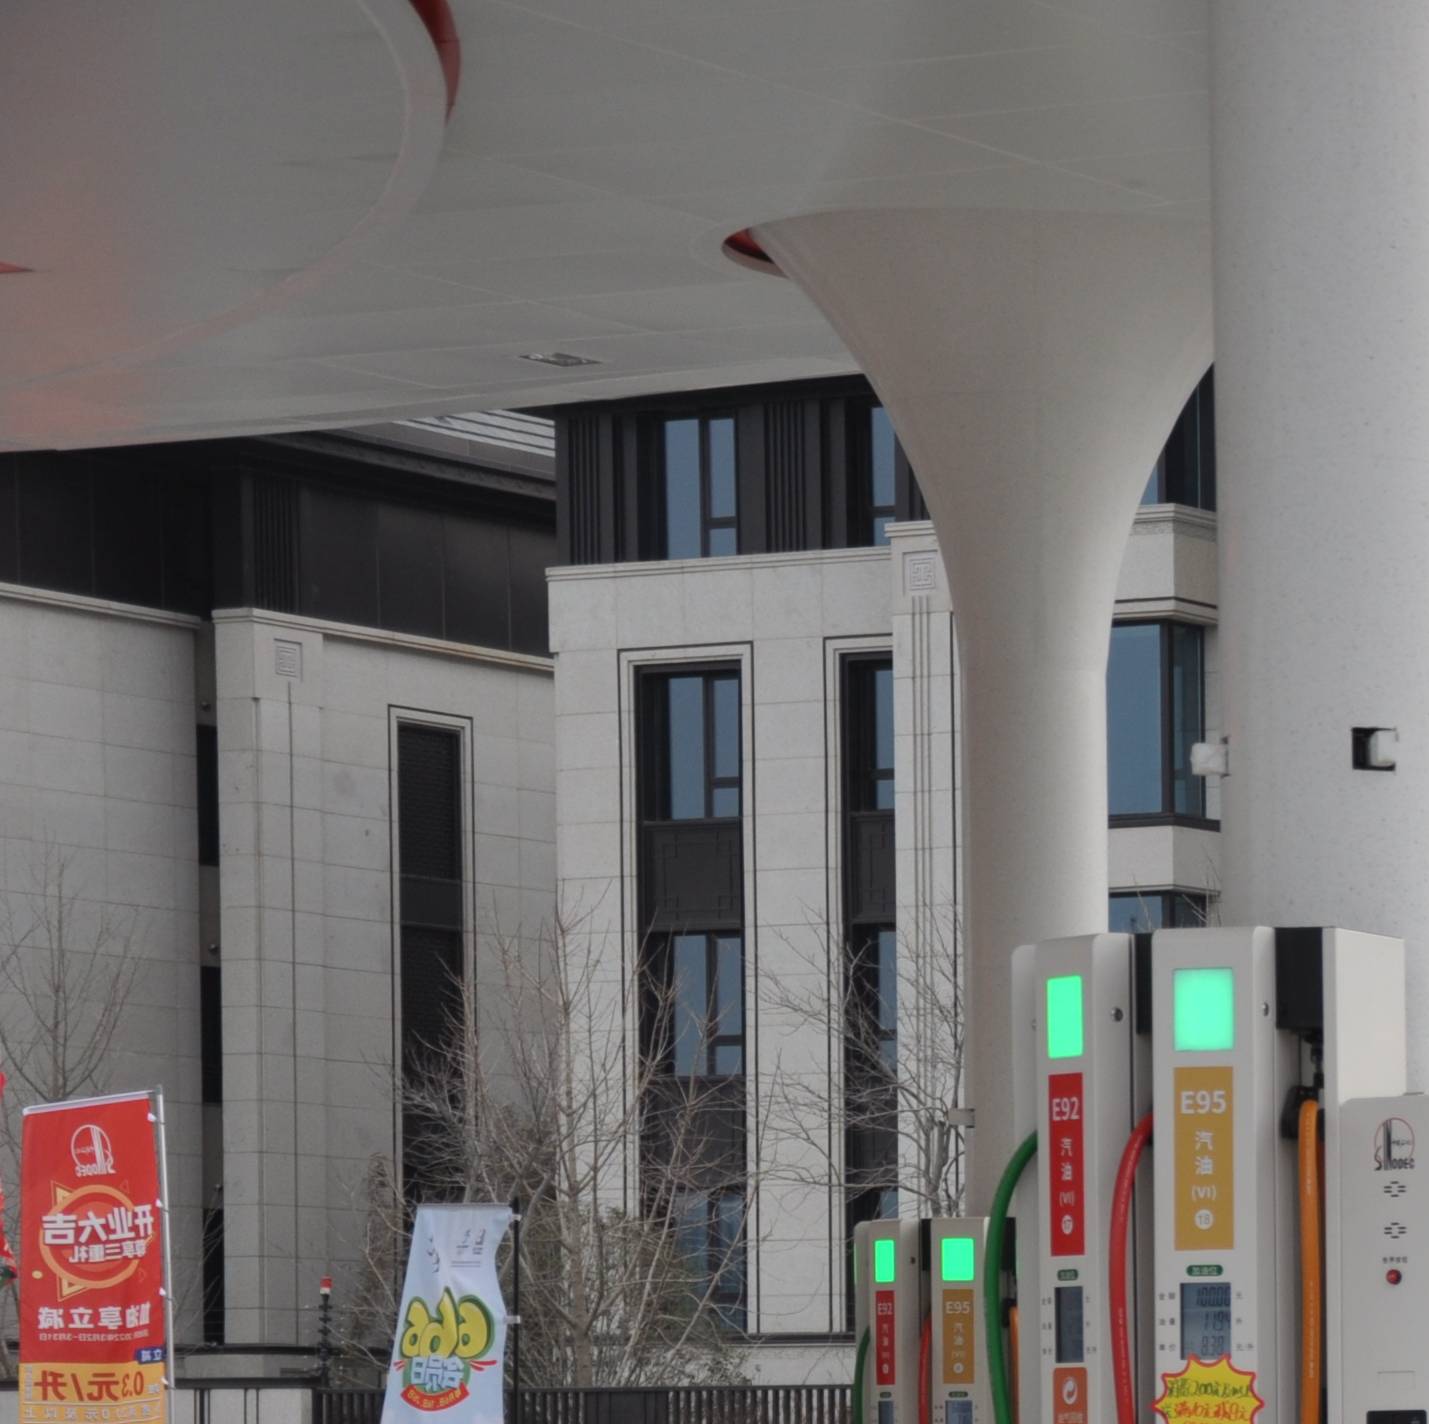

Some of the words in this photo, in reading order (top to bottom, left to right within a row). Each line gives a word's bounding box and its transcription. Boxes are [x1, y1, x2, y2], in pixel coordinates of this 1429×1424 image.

[1052, 1097, 1080, 1121] E92
[1180, 1090, 1226, 1114] E95
[1194, 1130, 1214, 1175] 汽油
[877, 1303, 893, 1315] E92
[945, 1302, 971, 1314] E95
